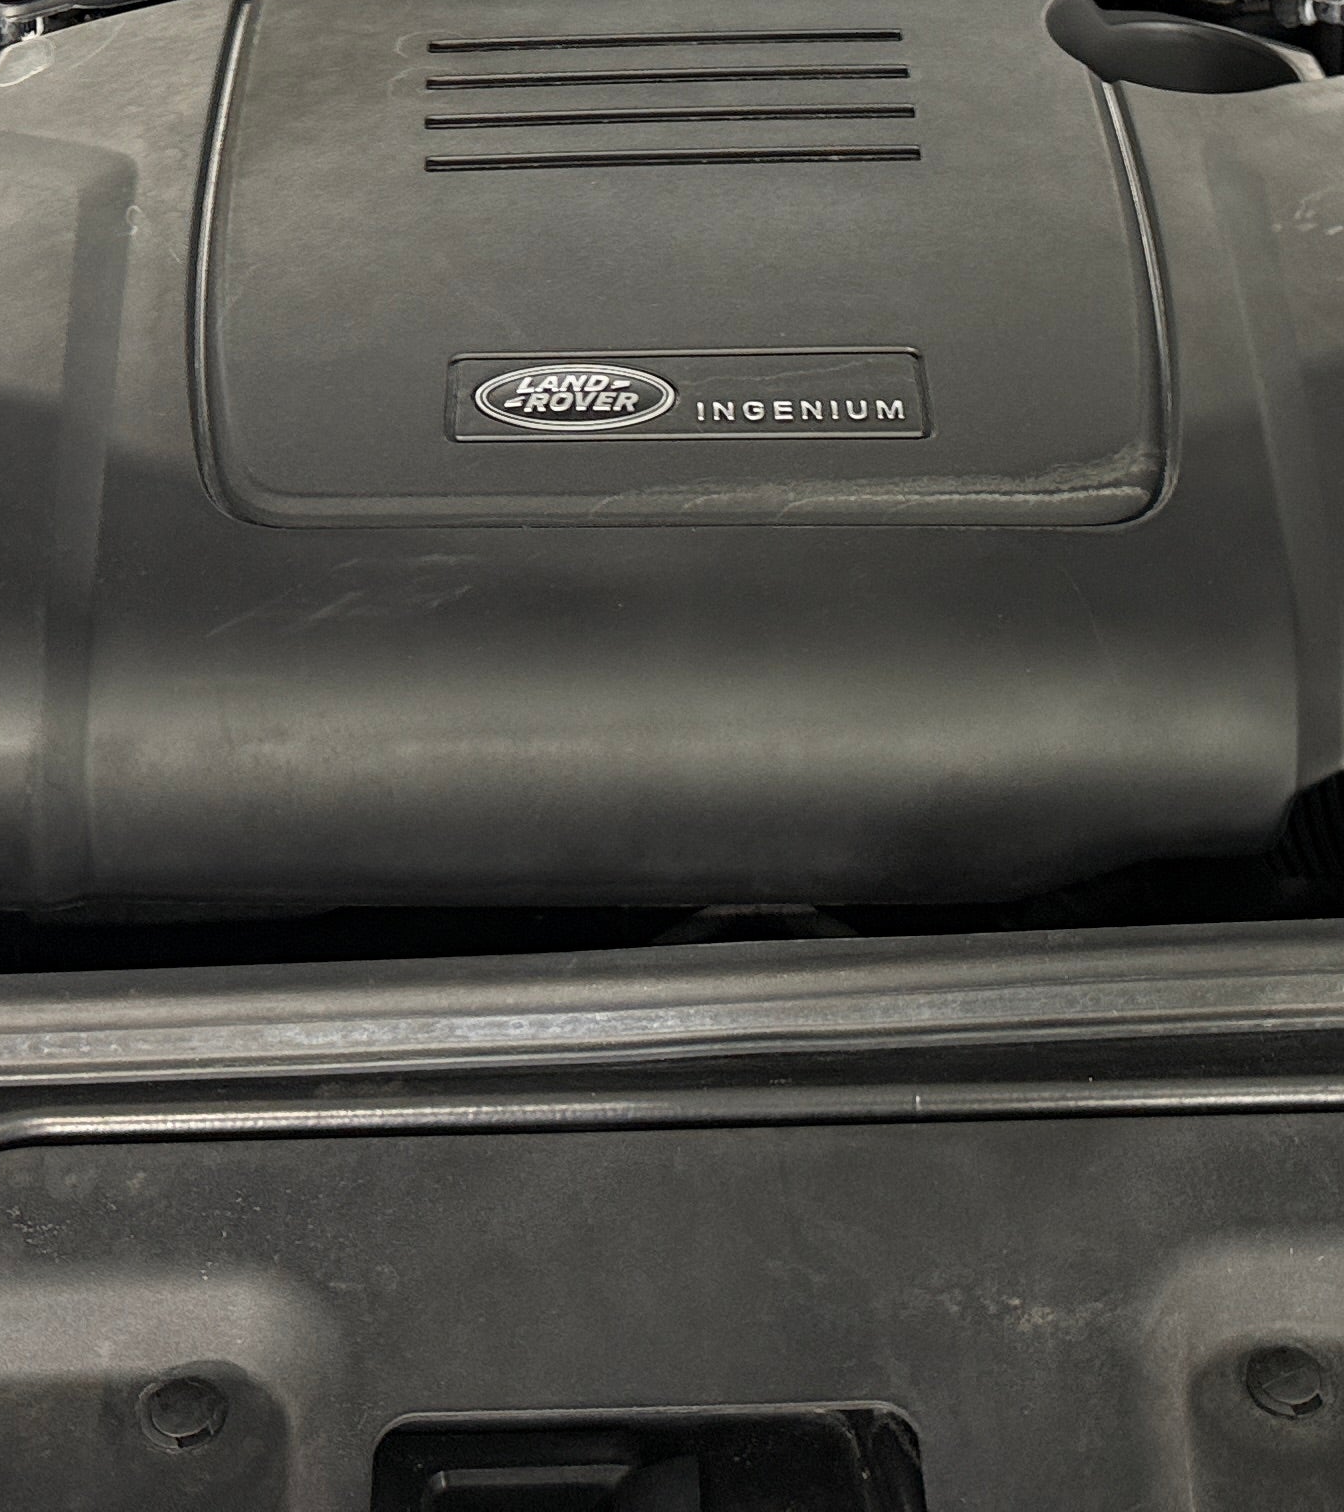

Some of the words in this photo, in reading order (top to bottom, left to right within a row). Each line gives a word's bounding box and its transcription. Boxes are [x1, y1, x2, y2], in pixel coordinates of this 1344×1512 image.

[515, 374, 613, 393] LAND
[524, 391, 640, 412] ROVER
[696, 399, 907, 422] INGENIUM
